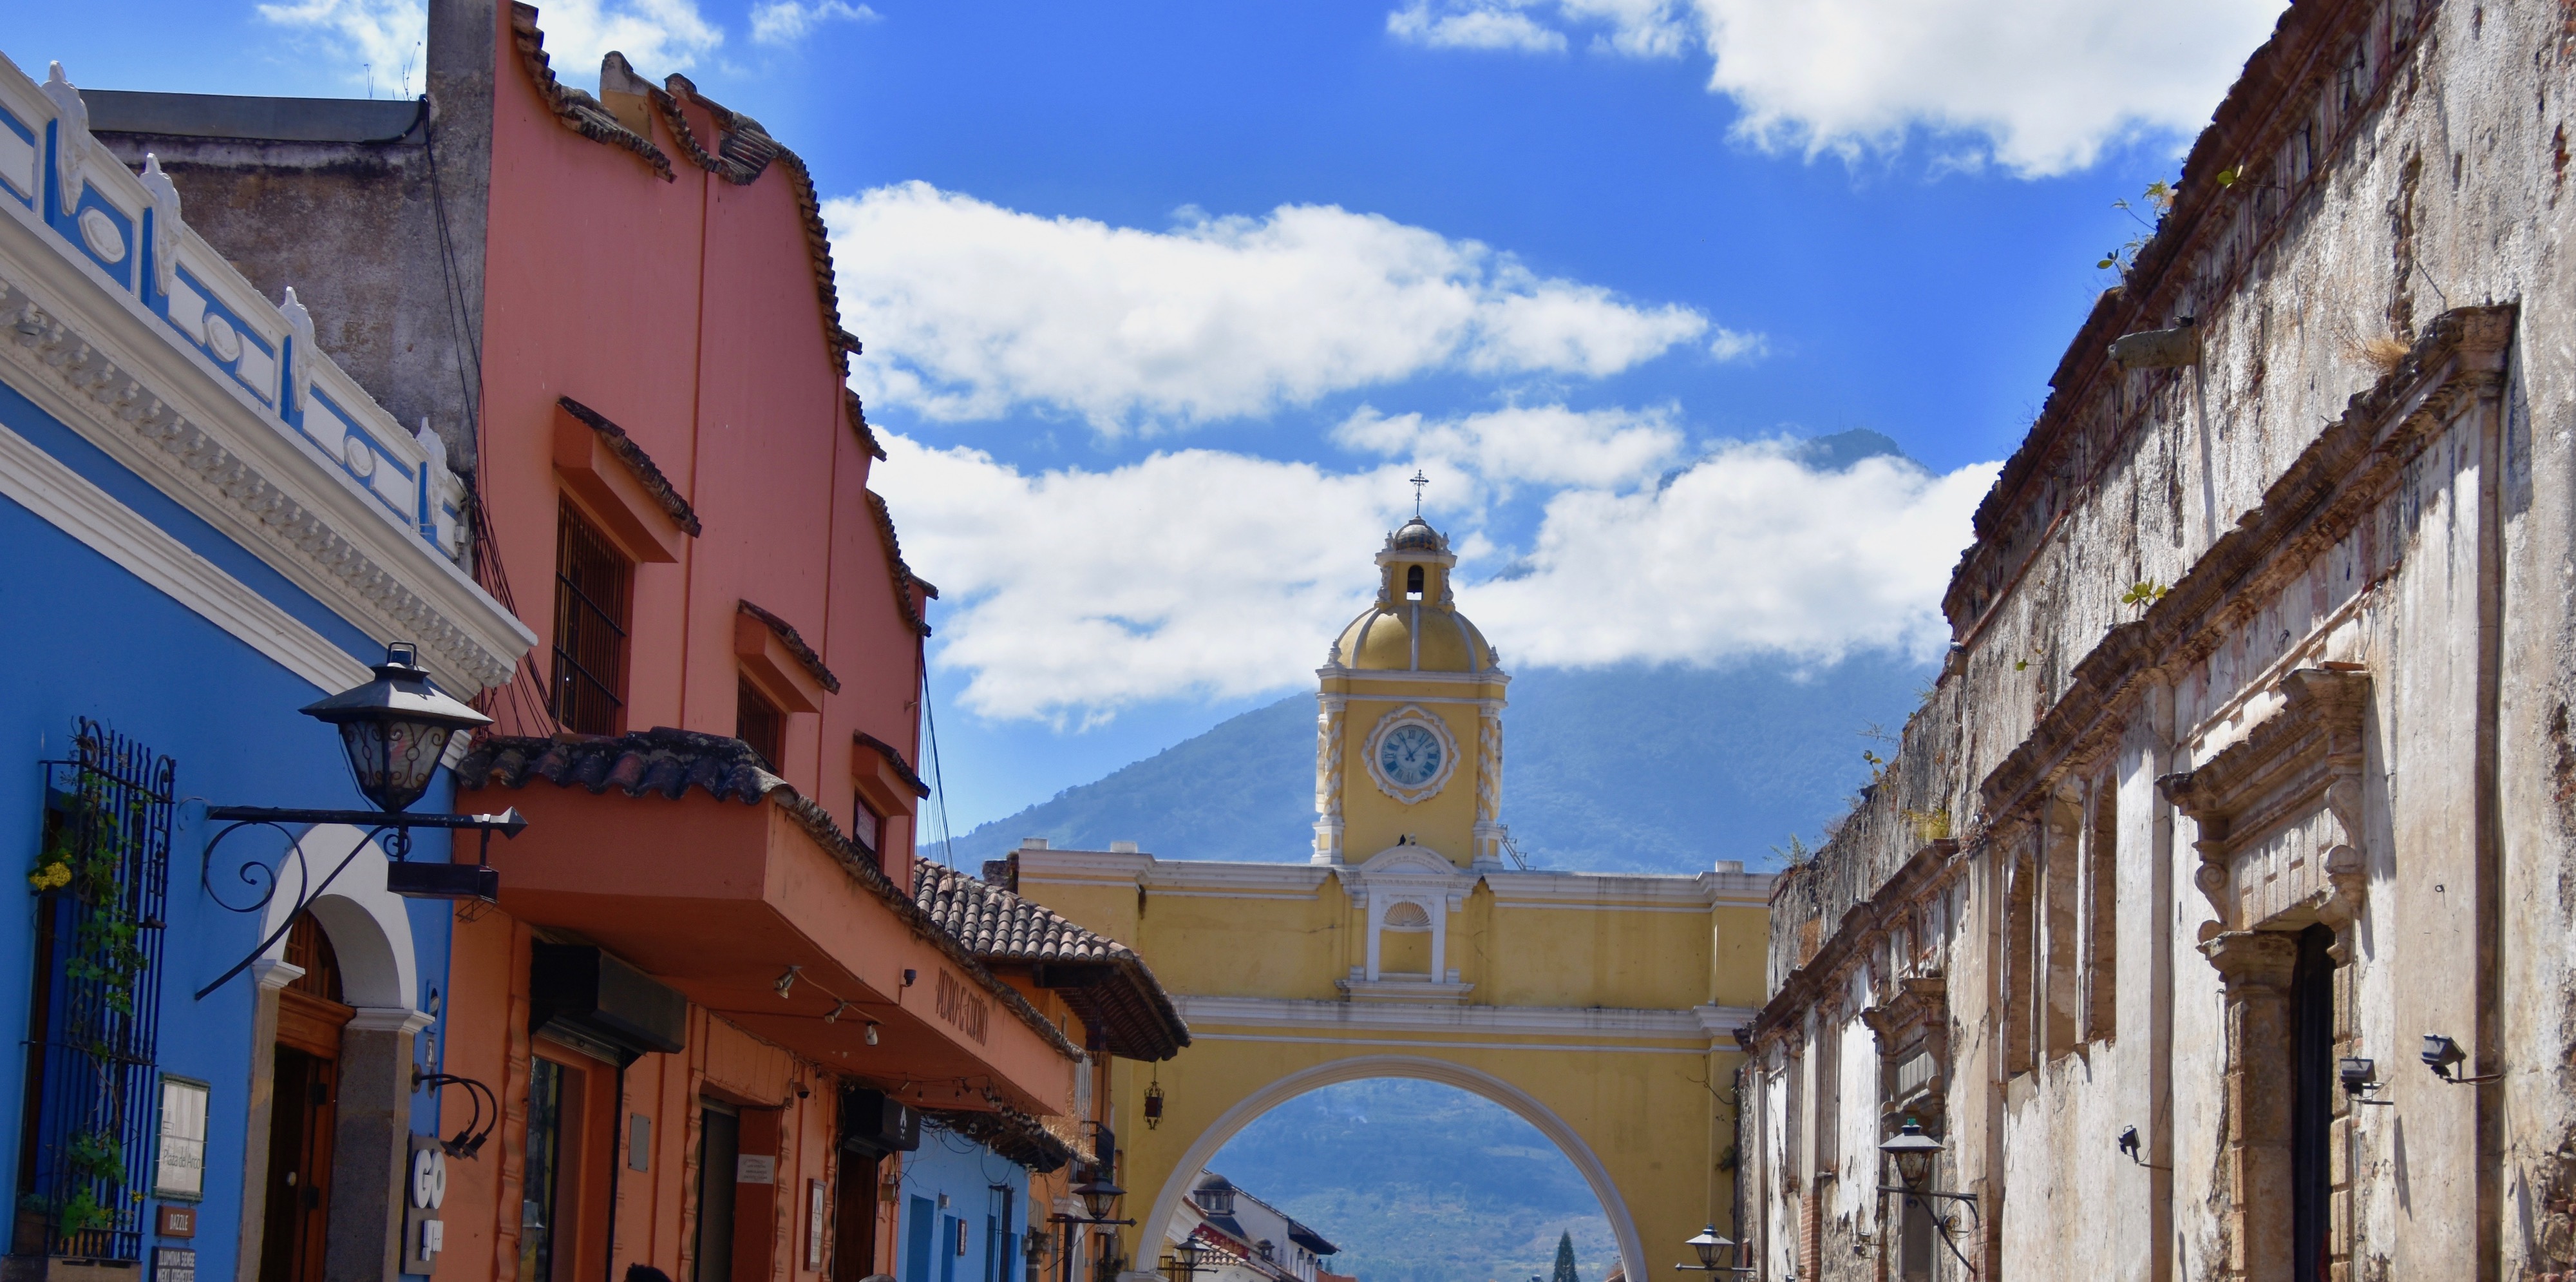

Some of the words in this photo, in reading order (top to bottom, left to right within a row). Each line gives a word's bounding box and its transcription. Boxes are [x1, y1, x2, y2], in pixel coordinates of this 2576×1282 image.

[163, 1143, 178, 1167] Plaza
[178, 1146, 187, 1167] del
[187, 1153, 201, 1169] Arco
[413, 1149, 446, 1209] GO
[170, 1214, 188, 1231] DAZZLE
[158, 1250, 180, 1267] ILUMINA
